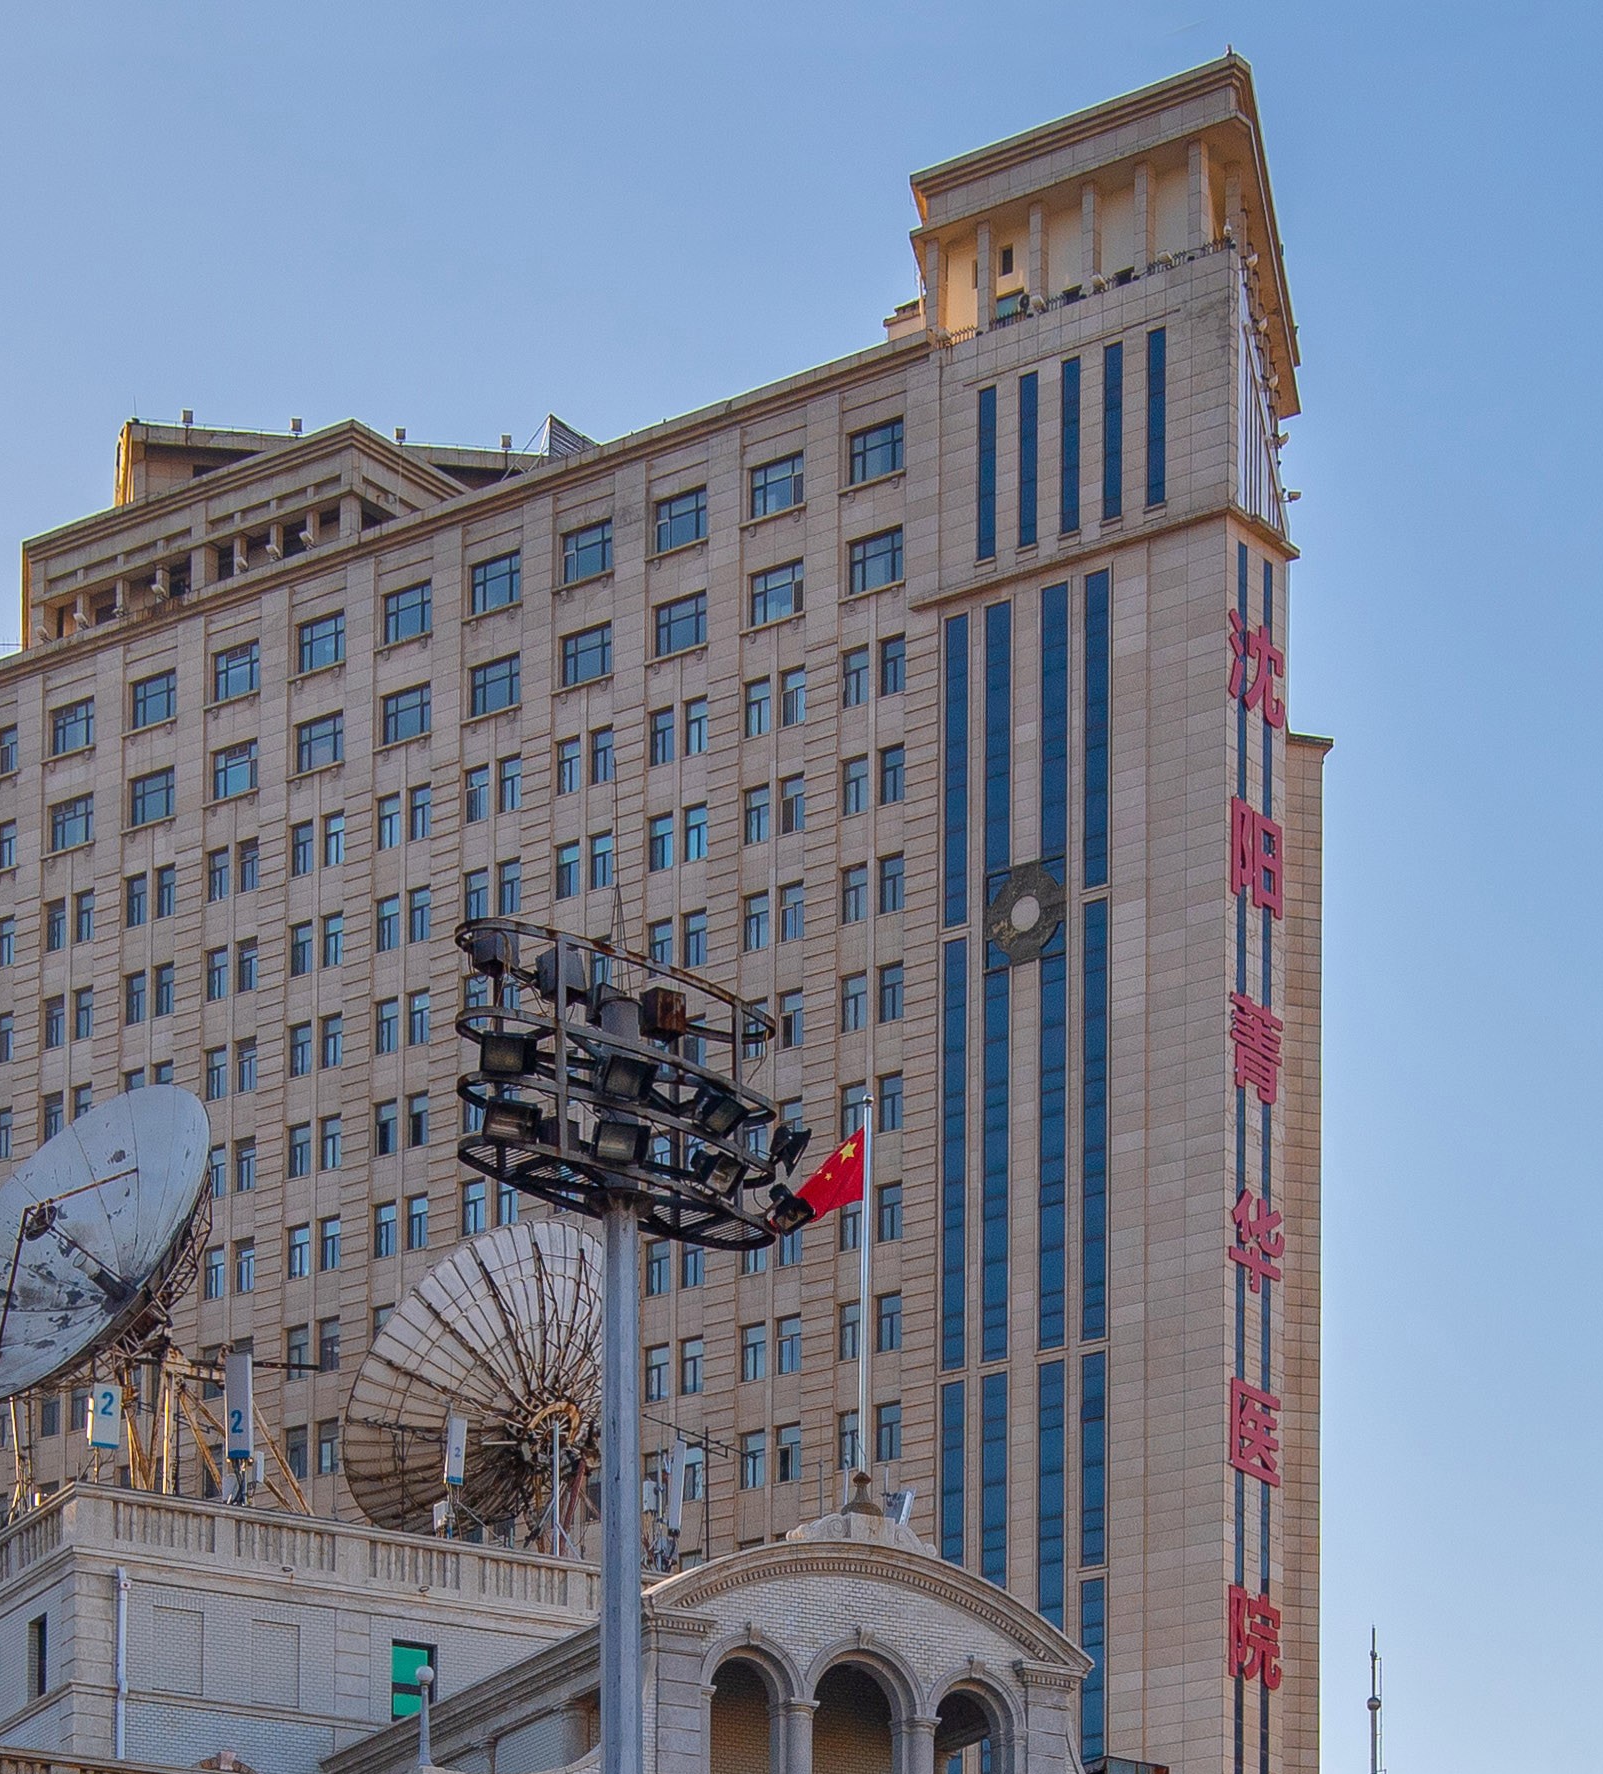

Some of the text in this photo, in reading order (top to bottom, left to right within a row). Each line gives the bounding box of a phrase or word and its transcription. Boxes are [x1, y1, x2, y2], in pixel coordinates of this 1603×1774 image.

[1228, 608, 1285, 1690] 沈阳菁华医院
